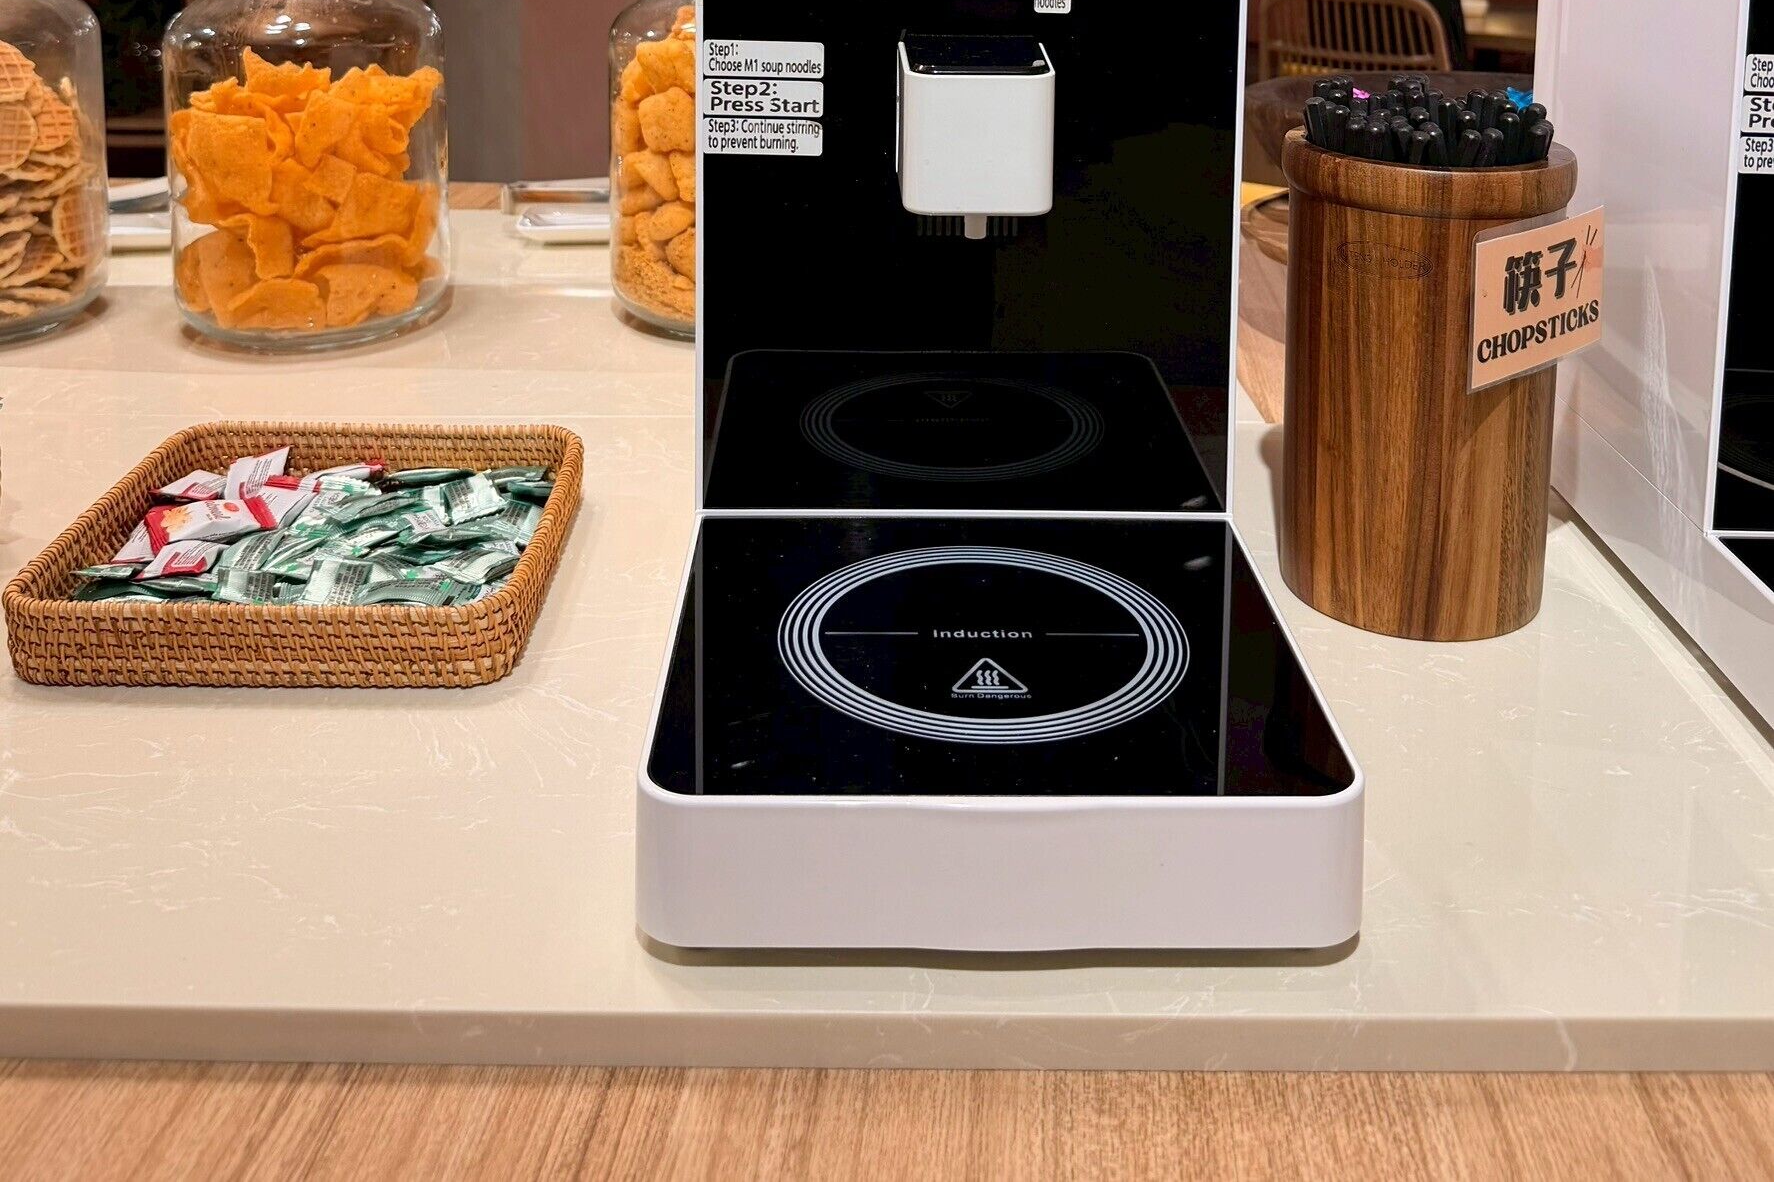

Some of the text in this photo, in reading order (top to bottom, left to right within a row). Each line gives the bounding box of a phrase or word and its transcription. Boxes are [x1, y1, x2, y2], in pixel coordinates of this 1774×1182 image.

[709, 42, 739, 59] Step1:
[708, 57, 821, 76] Choose M1 soup noodles
[710, 80, 778, 98] Step2:
[710, 97, 820, 113] Press Start
[1750, 97, 1774, 112] St
[708, 119, 821, 138] Step3: Continue stirring
[708, 135, 799, 153] to prevent burning.
[1743, 154, 1774, 172] to pre
[1503, 237, 1577, 315] 筷子
[1477, 299, 1600, 364] CHOPSTICKS
[933, 628, 1033, 639] Induction
